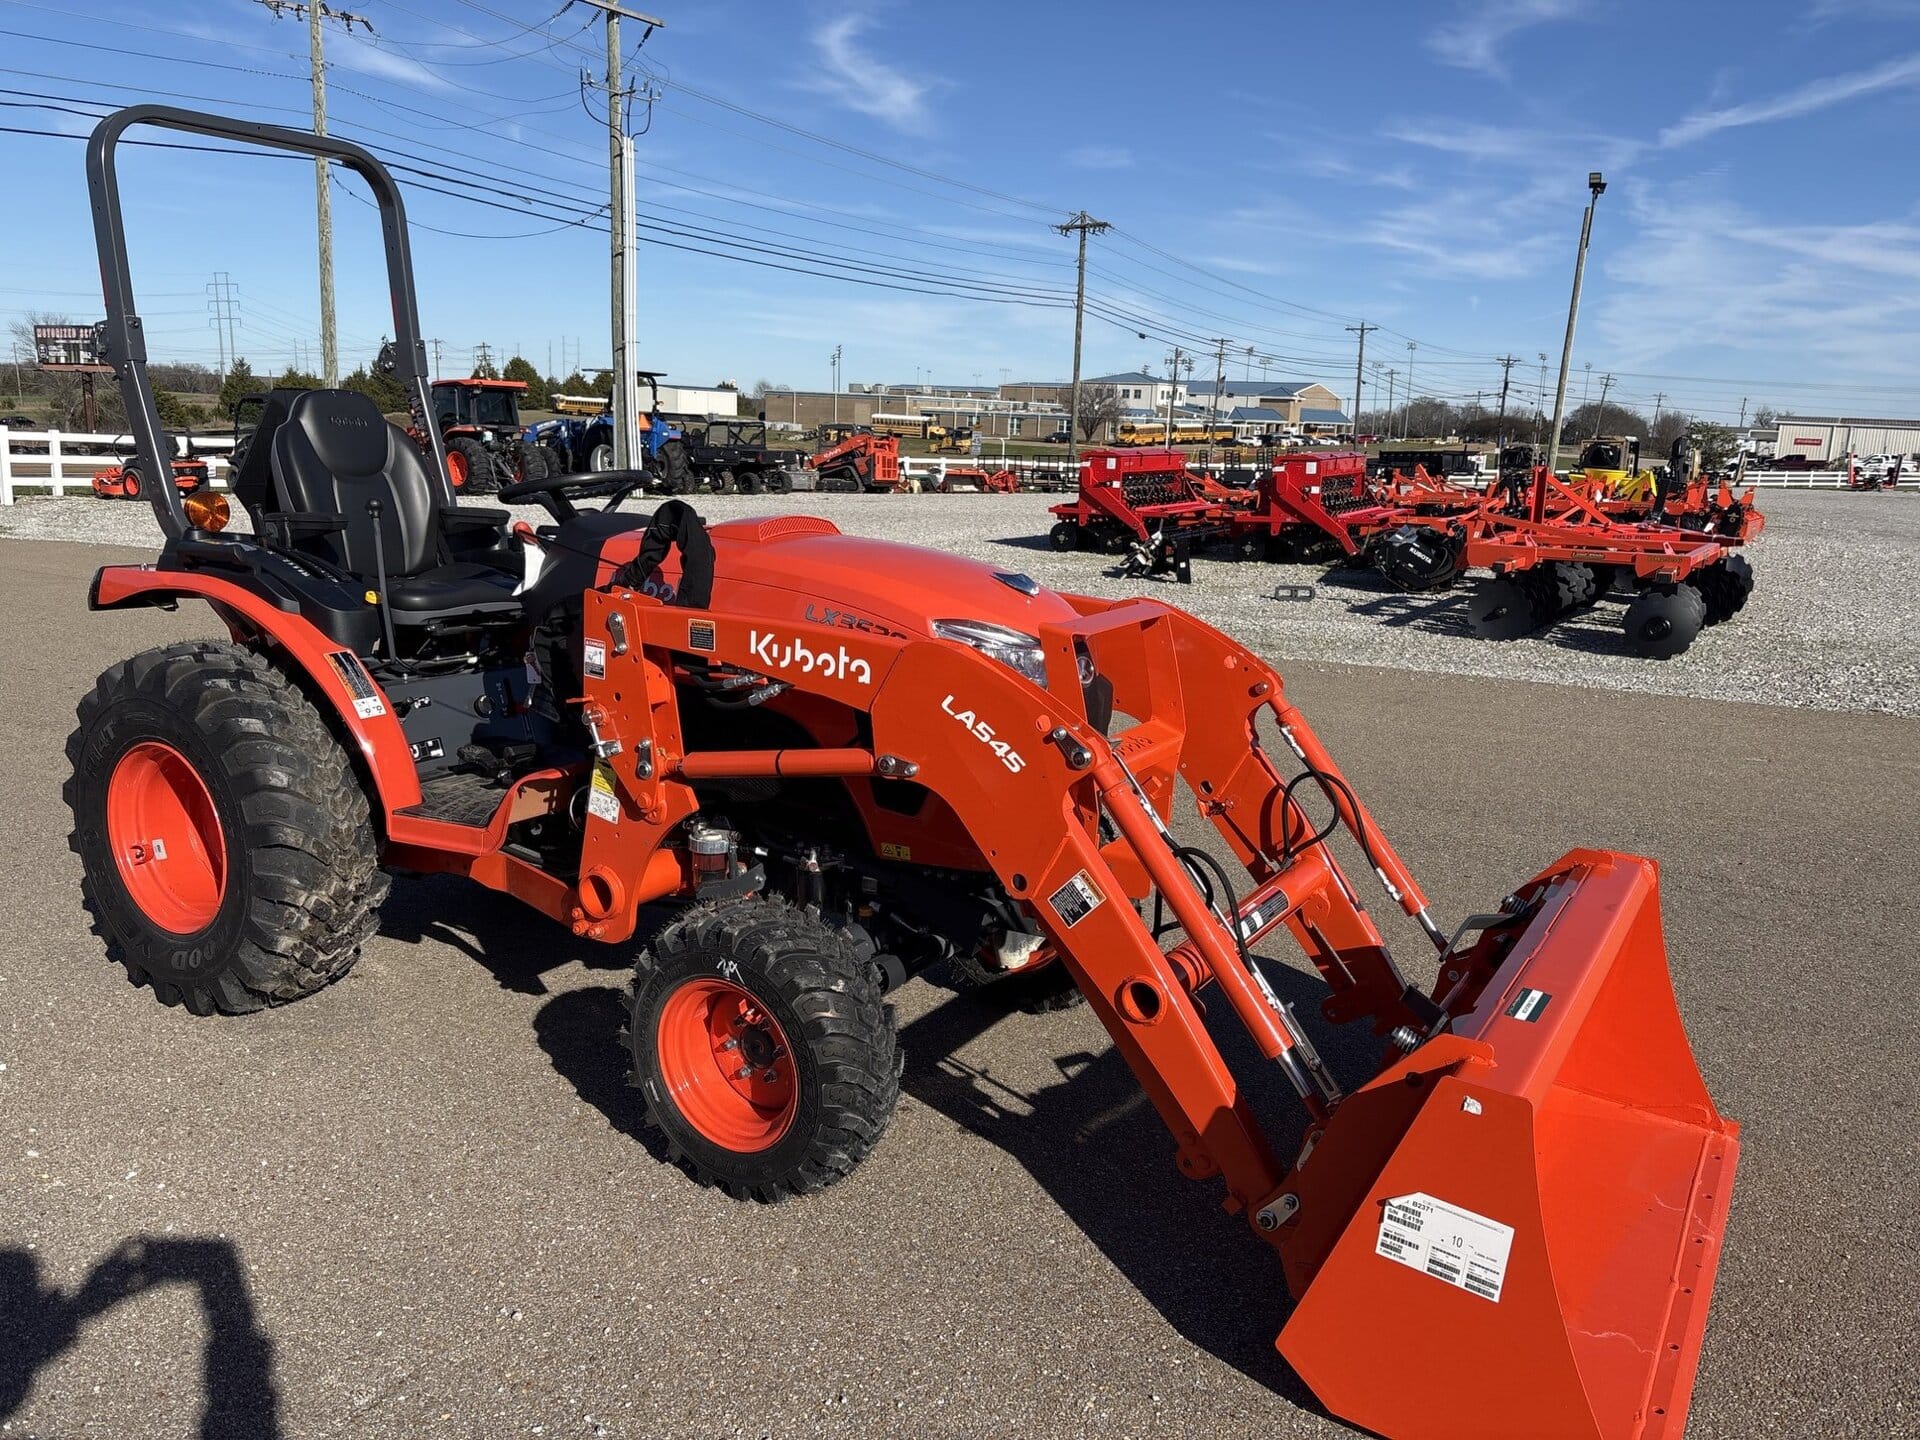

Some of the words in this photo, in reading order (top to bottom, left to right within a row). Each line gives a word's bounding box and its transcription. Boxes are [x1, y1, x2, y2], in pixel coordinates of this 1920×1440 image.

[1408, 546, 1433, 565] KUBOTA
[750, 630, 871, 685] Kubota
[941, 694, 1027, 773] LA545
[1412, 1200, 1435, 1214] B2371
[1451, 1235, 1464, 1249] 10
